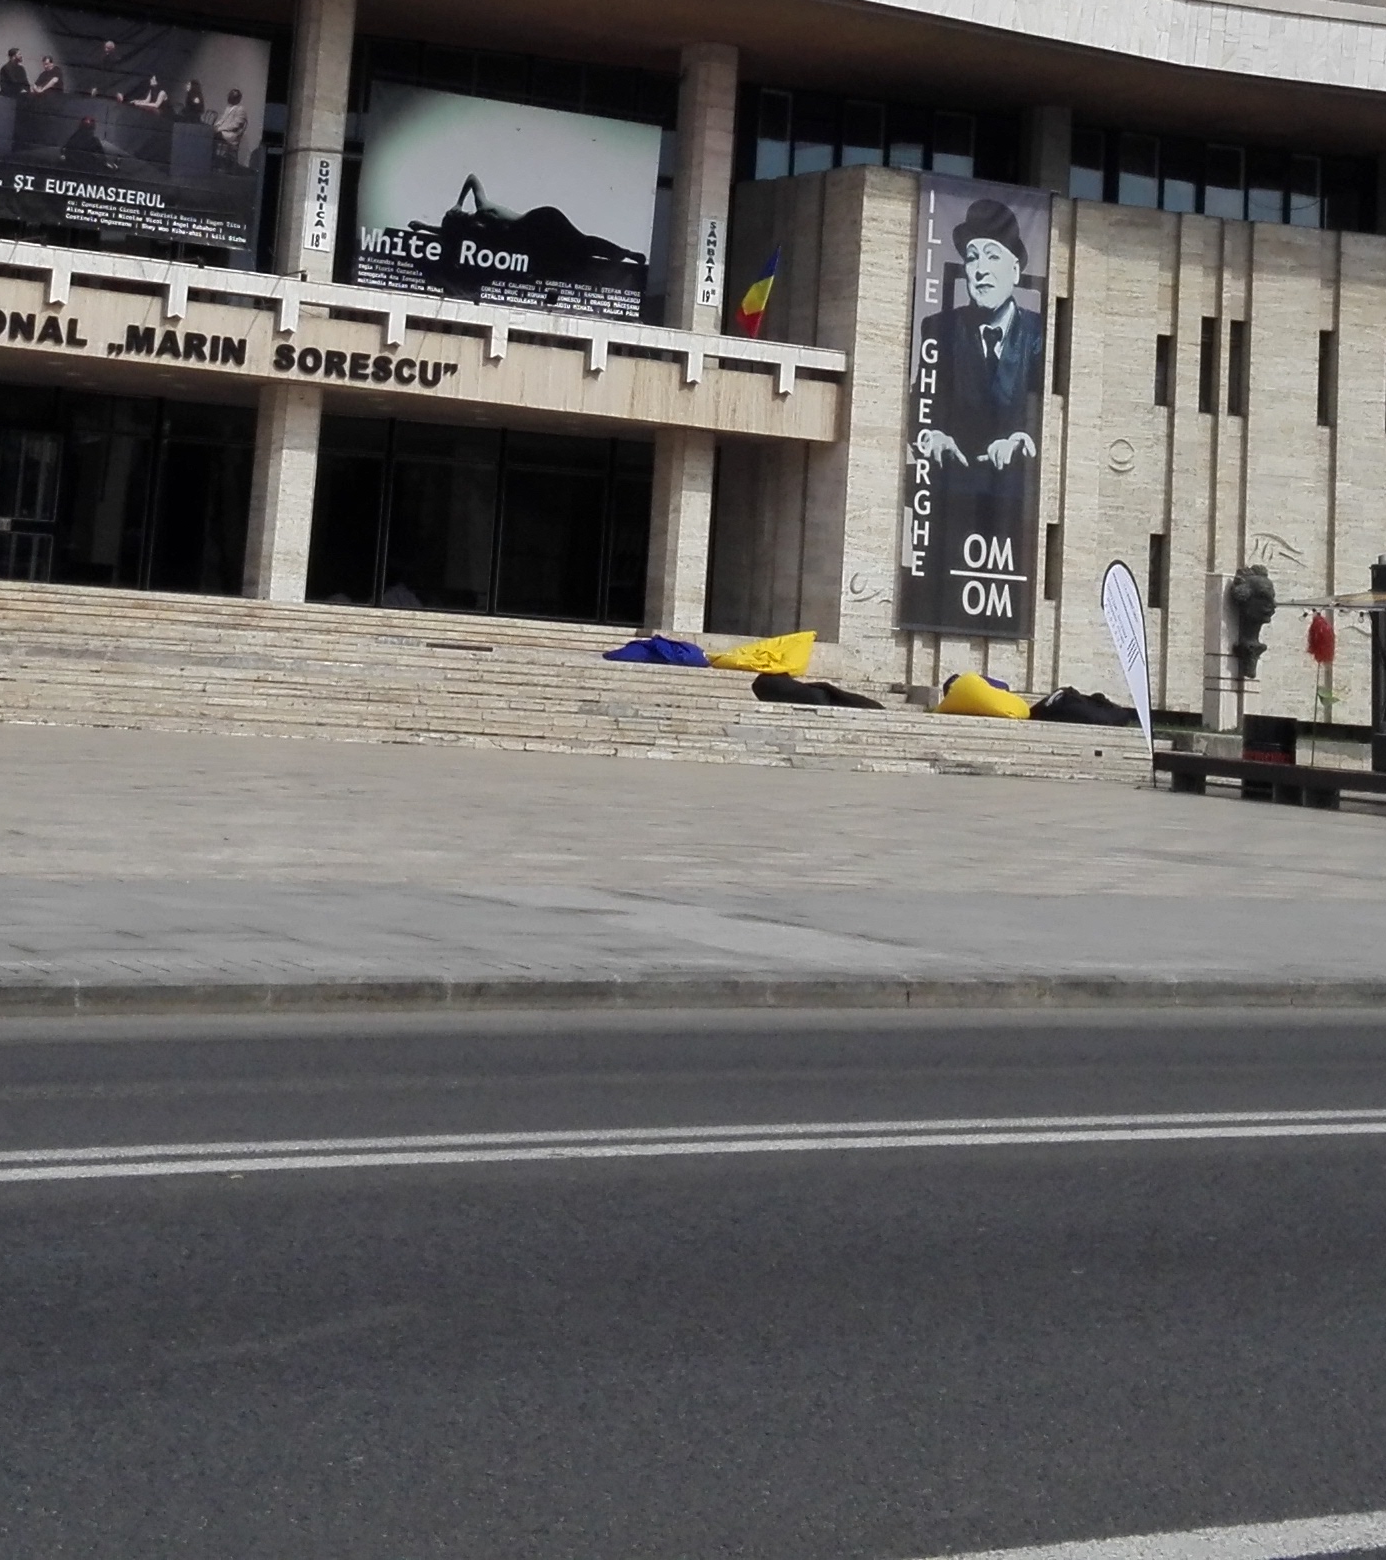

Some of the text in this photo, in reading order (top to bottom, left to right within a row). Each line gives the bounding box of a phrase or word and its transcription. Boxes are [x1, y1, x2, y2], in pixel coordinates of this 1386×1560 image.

[13, 175, 35, 193] ȘI
[46, 179, 165, 208] EUTANASIERUL
[315, 161, 329, 227] DUMINICA
[361, 226, 529, 272] White Room
[704, 222, 716, 283] SAMBATA
[545, 280, 571, 288] GABRIELA
[911, 190, 942, 577] ILIE GHEORGHE
[963, 533, 1014, 570] OM
[962, 581, 1013, 618] OM
